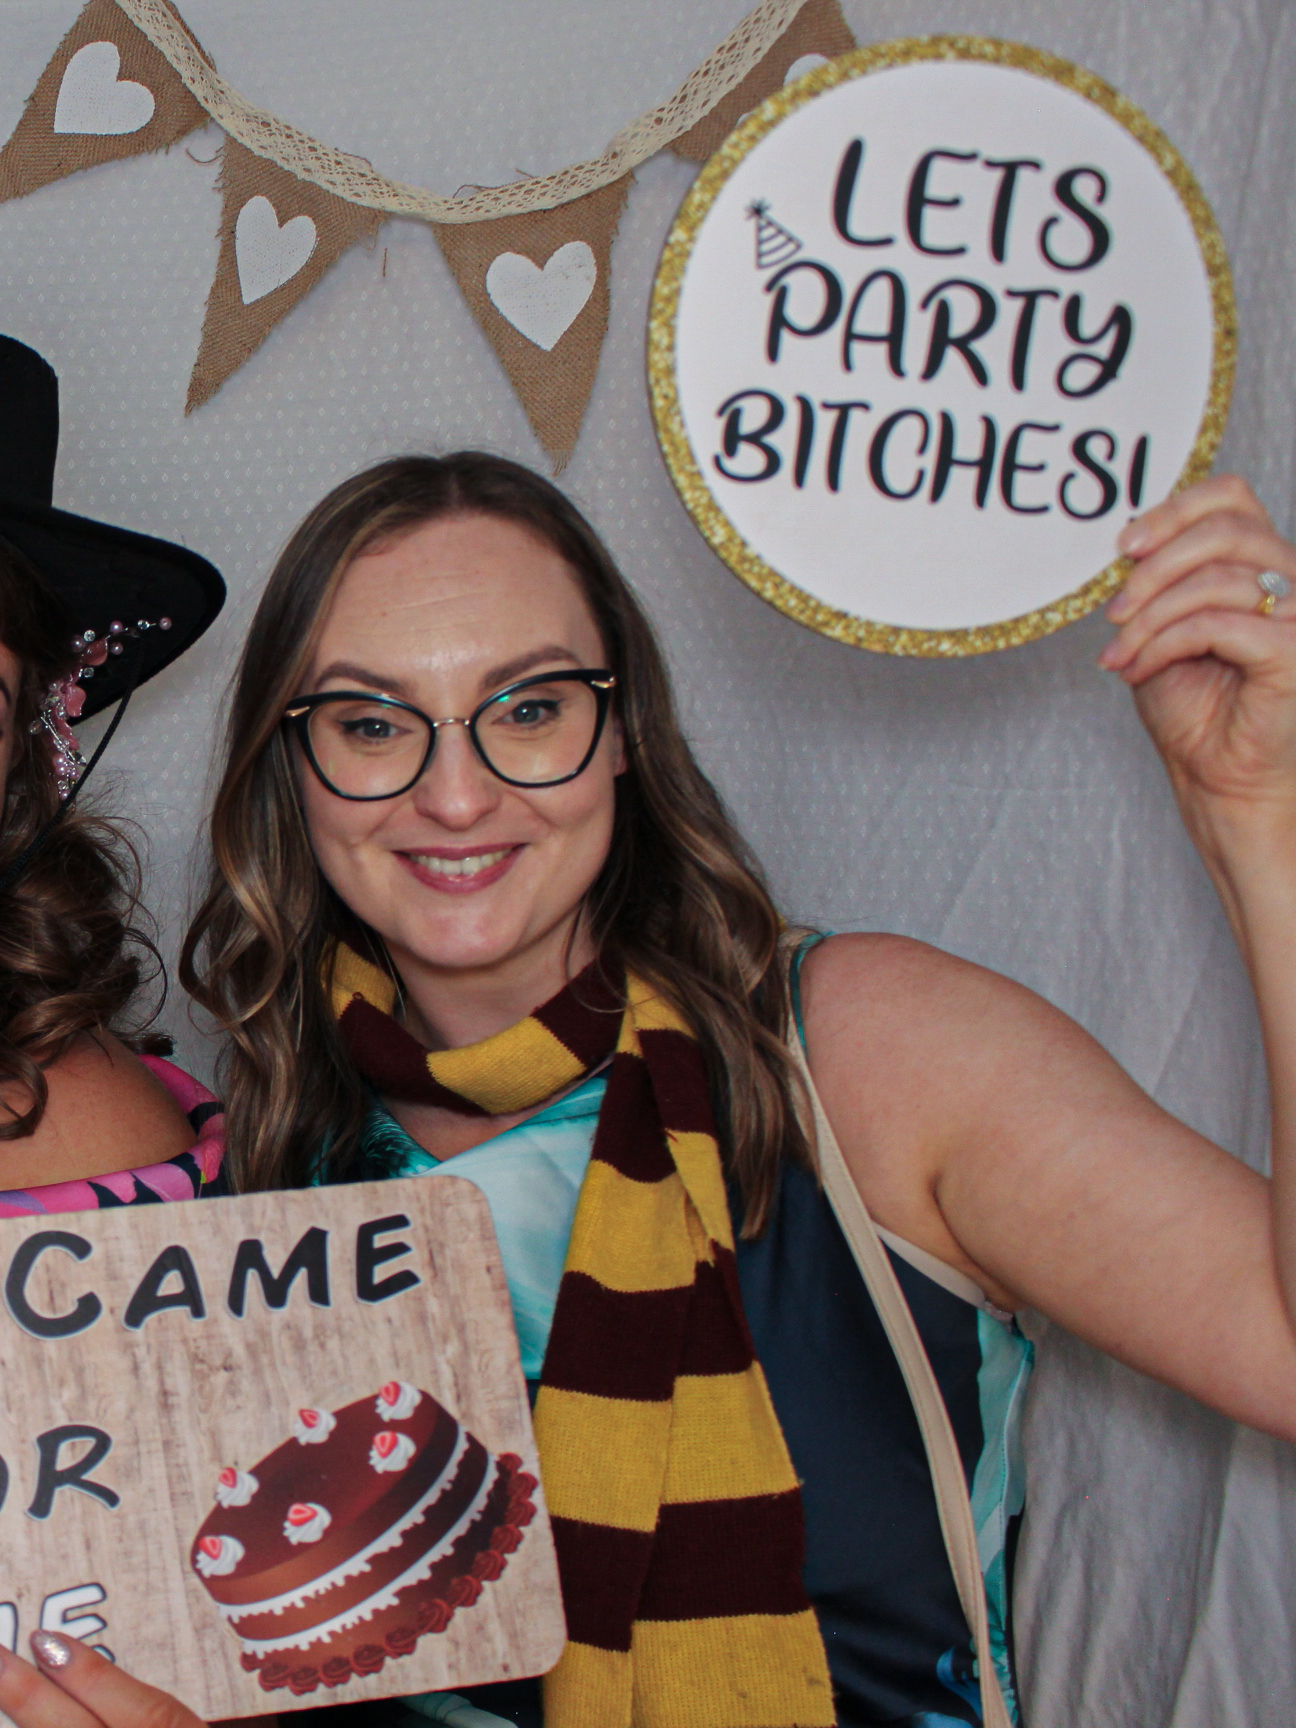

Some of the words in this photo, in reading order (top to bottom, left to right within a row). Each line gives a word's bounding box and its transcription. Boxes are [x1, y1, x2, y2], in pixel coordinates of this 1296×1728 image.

[833, 139, 1110, 271] LETS
[764, 261, 1133, 398] PARTY
[714, 389, 1149, 521] BITCHES!
[5, 1214, 421, 1339] CAME
